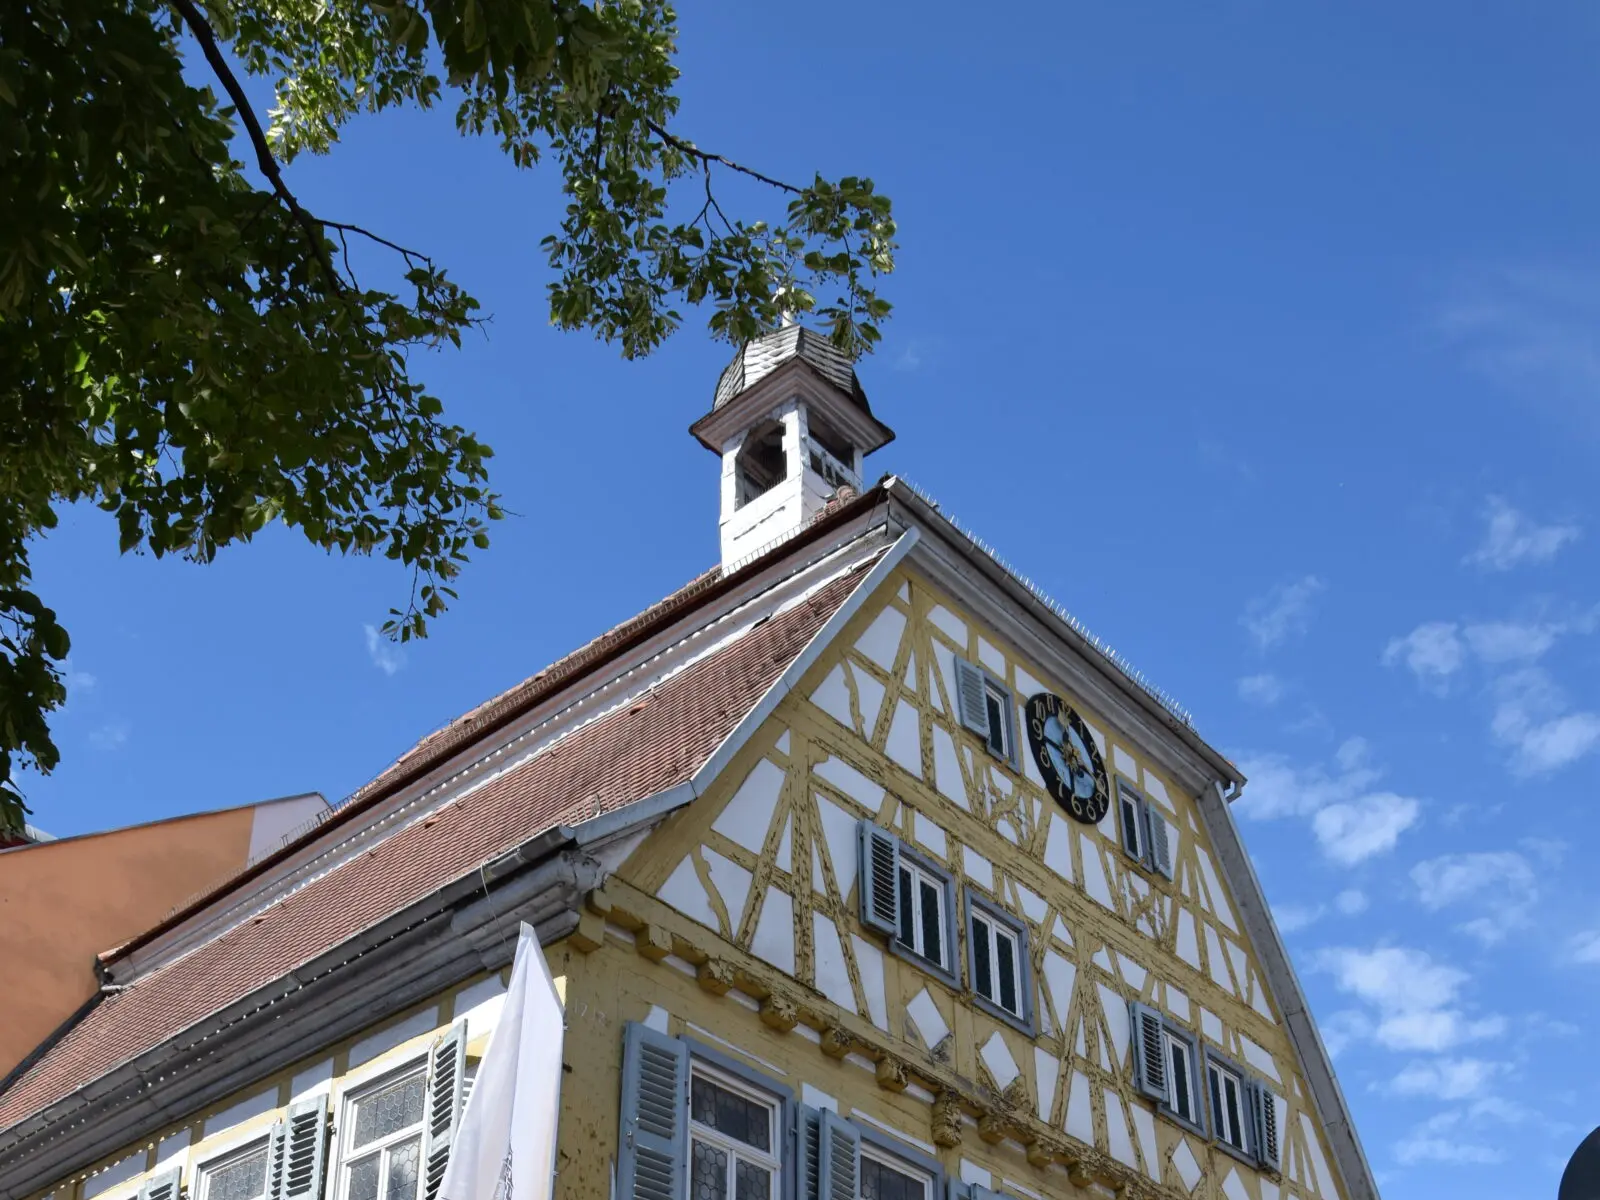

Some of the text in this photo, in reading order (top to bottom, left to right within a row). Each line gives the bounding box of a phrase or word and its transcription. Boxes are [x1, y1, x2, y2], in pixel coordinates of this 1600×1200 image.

[1033, 699, 1046, 721] 10
[1032, 718, 1043, 740] 9
[1040, 745, 1051, 768] 8
[1090, 741, 1100, 763] 2
[1055, 776, 1064, 798] 7
[1071, 794, 1082, 815] 6
